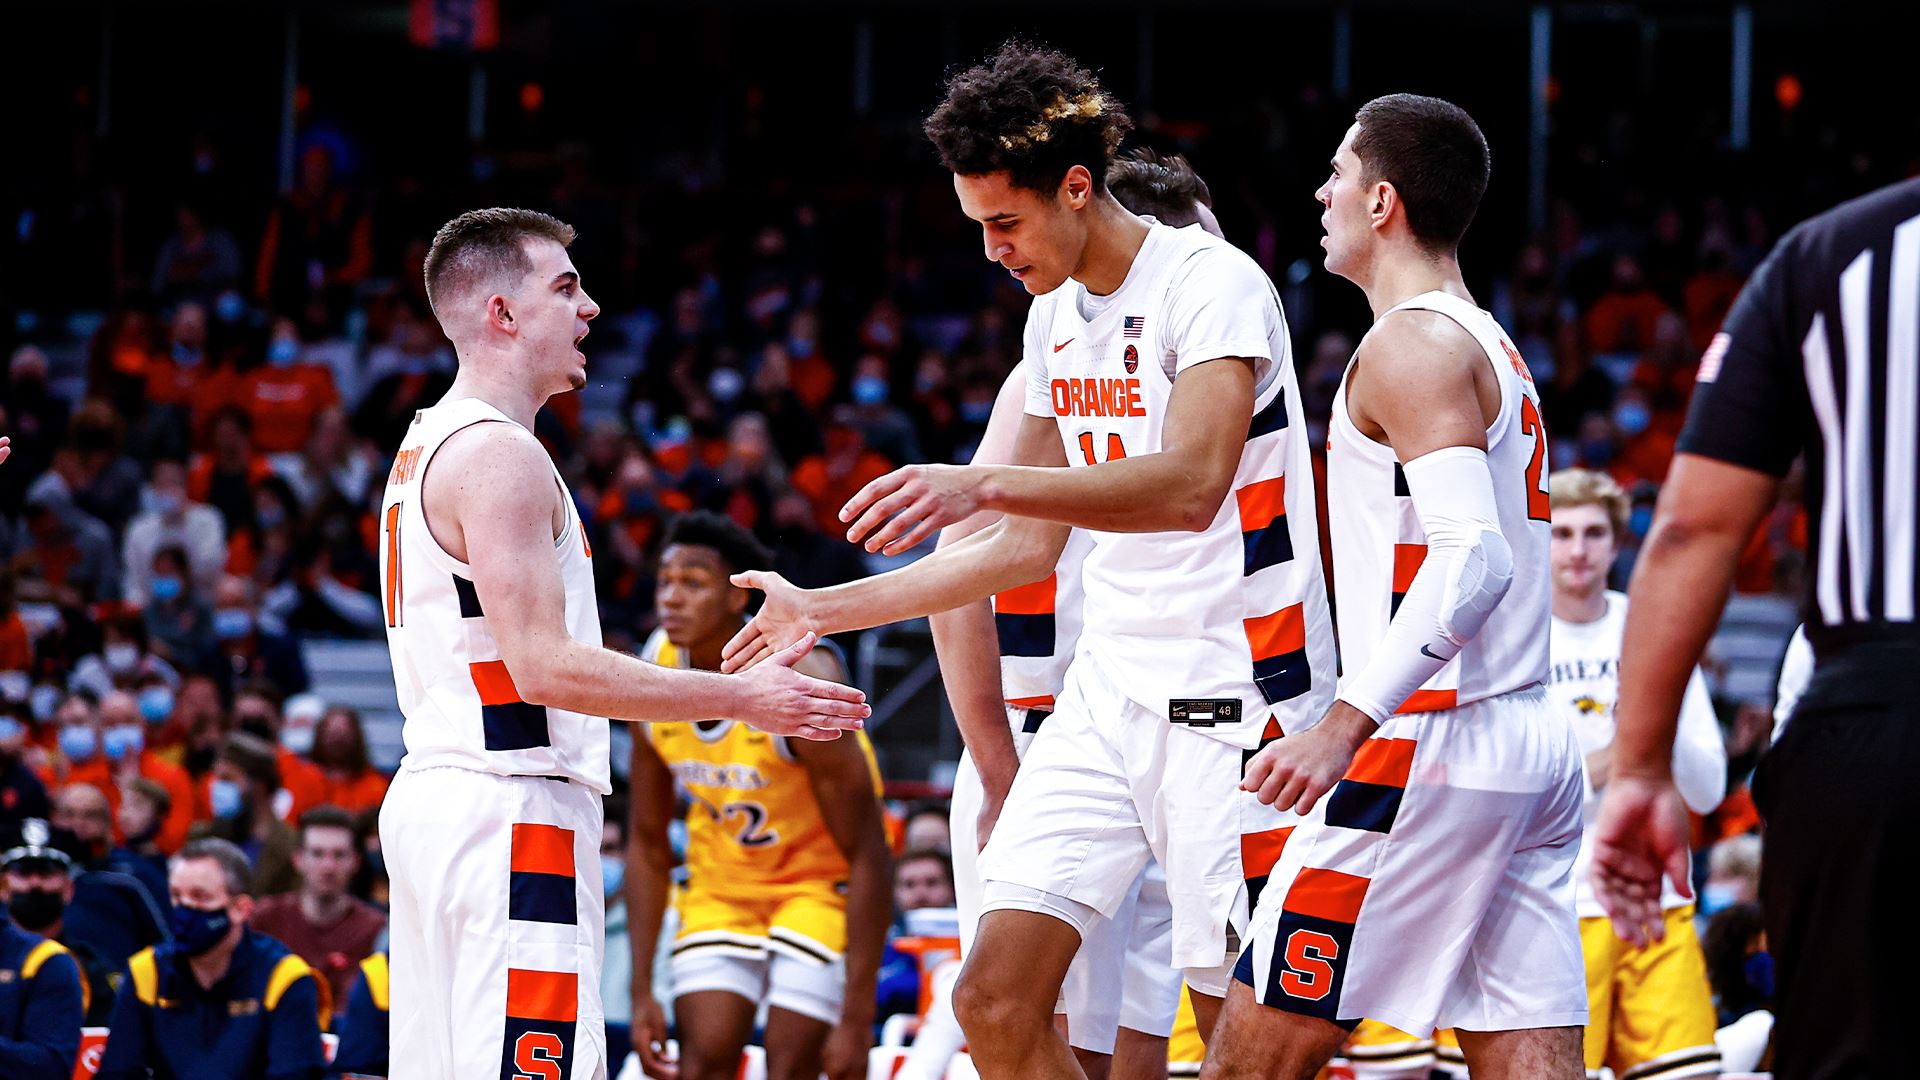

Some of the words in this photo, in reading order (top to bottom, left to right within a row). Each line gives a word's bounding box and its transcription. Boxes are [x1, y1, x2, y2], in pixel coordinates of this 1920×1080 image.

[1051, 378, 1146, 417] ORANGE
[1218, 705, 1232, 716] 48
[1279, 928, 1339, 1001] S
[511, 1031, 563, 1080] S
